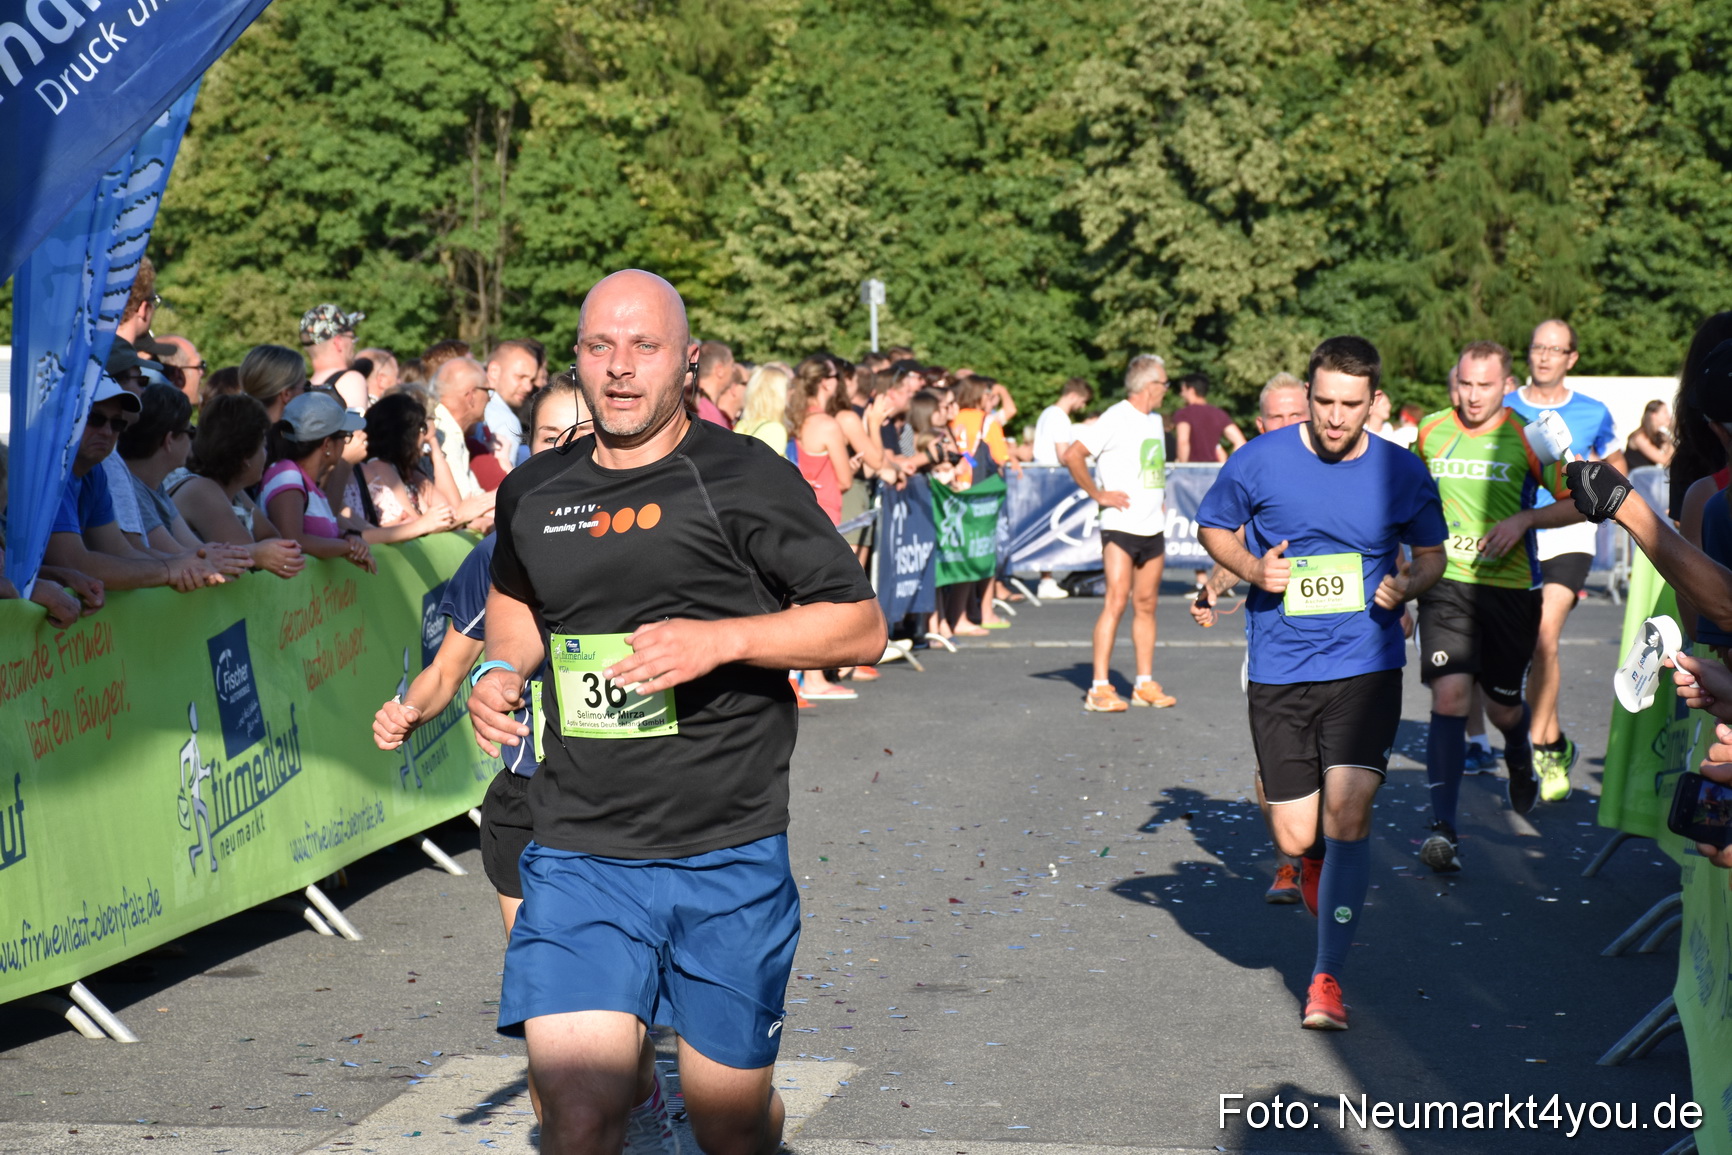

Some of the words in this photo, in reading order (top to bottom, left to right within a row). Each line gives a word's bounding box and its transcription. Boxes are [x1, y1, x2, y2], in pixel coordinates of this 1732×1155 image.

[34, 22, 128, 116] Druck
[554, 504, 596, 517] APTIV
[543, 522, 577, 534] Running
[578, 520, 599, 530] Team
[1301, 575, 1345, 598] 669
[0, 631, 54, 706] esunde
[222, 663, 249, 693] Fischer
[582, 672, 628, 709] 36
[577, 710, 616, 719] Selimovic
[618, 710, 645, 719] Mirza
[642, 718, 665, 726] GmbH
[211, 702, 302, 832] firmenlauf
[219, 809, 266, 860] neumarkt
